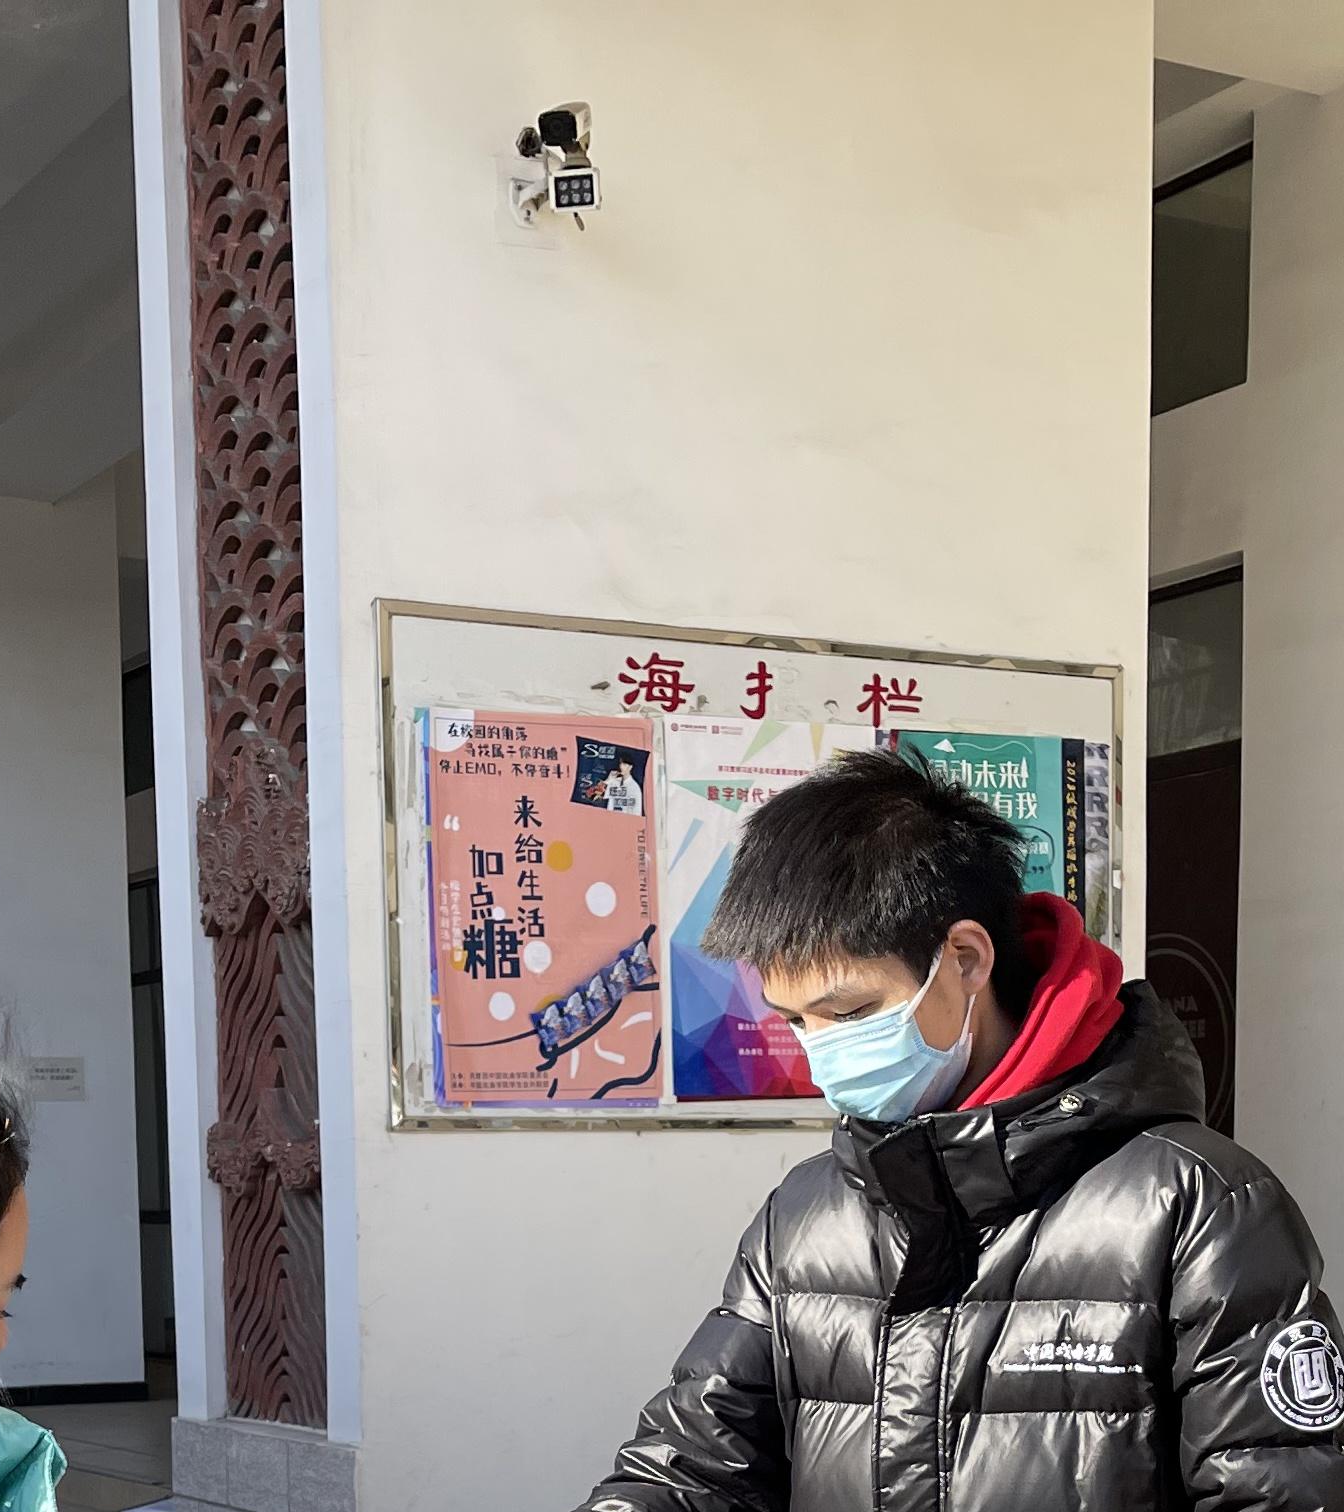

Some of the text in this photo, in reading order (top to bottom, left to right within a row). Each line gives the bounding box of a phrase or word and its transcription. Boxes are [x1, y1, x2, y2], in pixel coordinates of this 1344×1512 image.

[447, 723, 529, 742] 在校园的角落
[463, 844, 524, 980] 加点糖
[513, 795, 545, 938] 来给生活
